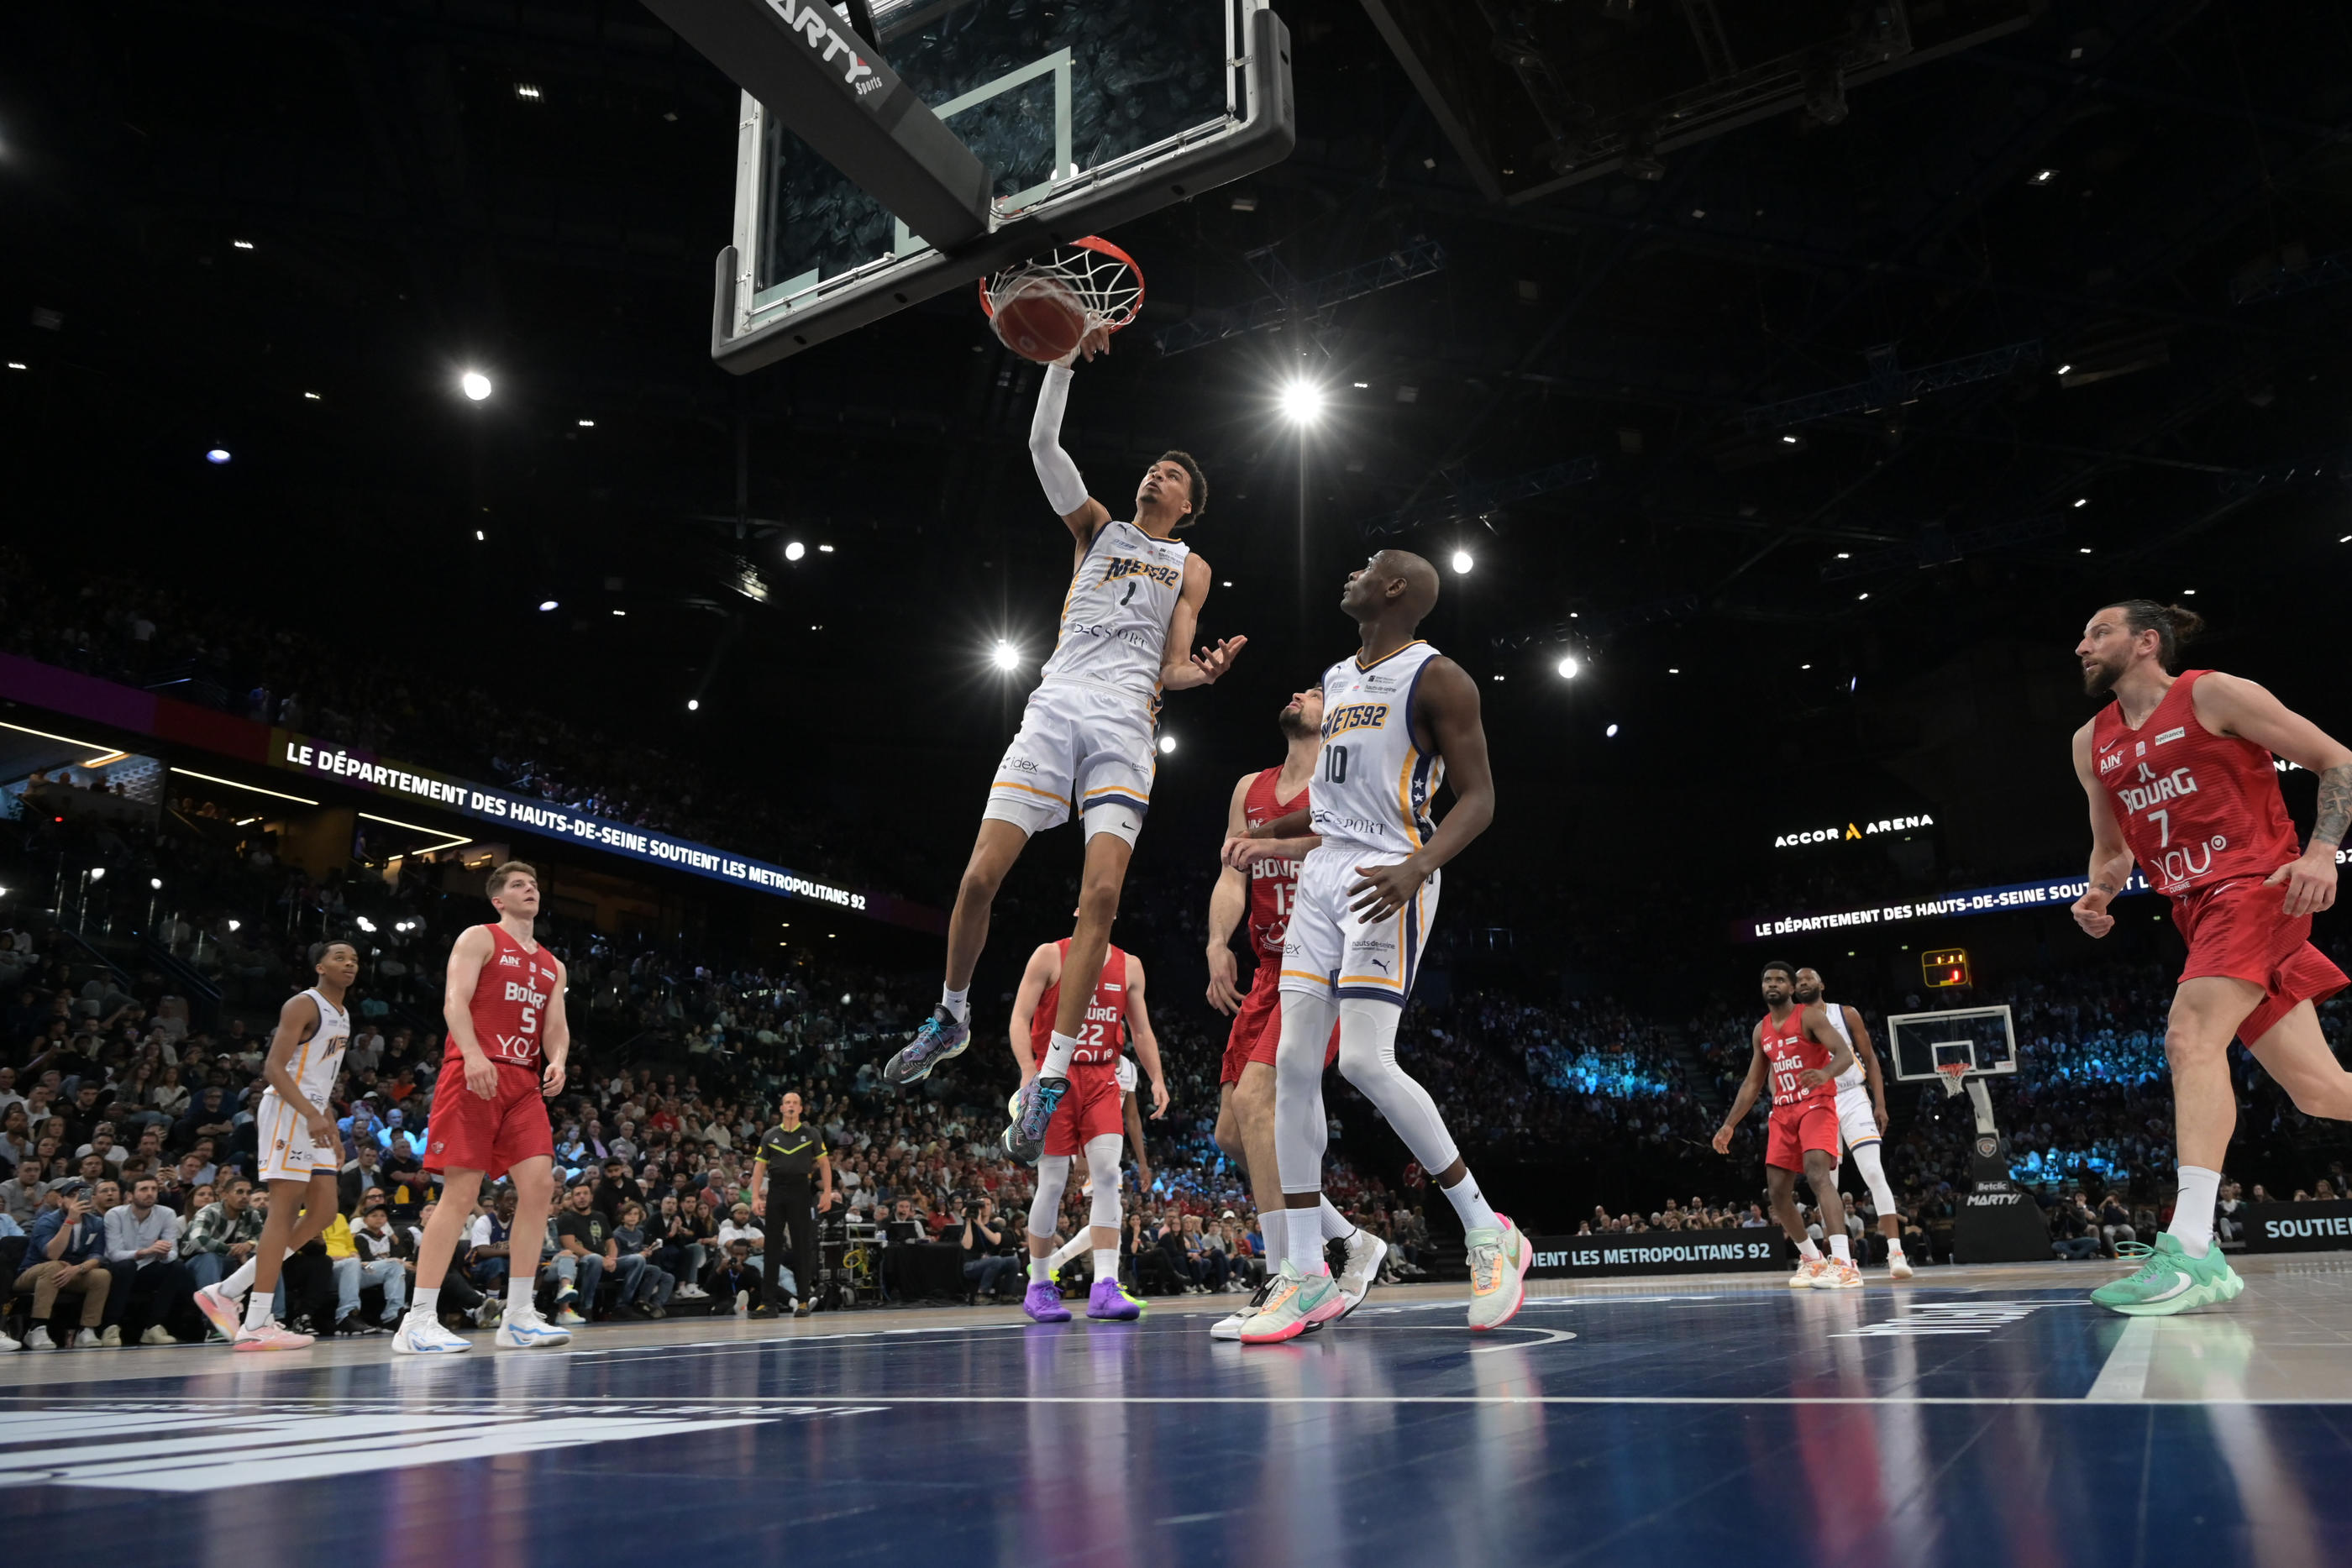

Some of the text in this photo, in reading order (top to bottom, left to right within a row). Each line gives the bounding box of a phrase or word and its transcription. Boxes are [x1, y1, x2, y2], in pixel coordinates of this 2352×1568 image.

[765, 0, 872, 83] ARTY
[855, 76, 883, 95] Sports
[1120, 581, 1137, 606] 1
[1011, 757, 1039, 773] idex
[1326, 744, 1347, 784] 10
[2100, 754, 2121, 773] AIN
[2118, 768, 2198, 815] BOURG
[286, 742, 866, 910] LE DÉPARTEMENT DES HAUTS-DE-SEINE SOUTIENT LES METROPOLITANS 92
[1775, 814, 1934, 848] ACCOR ARENA
[2147, 809, 2168, 848] 7
[1252, 858, 1305, 880] BOUR
[2169, 881, 2192, 894] CUISINE
[1755, 922, 1772, 937] LE
[1774, 909, 1880, 935] DÉPARTEMENT
[1883, 905, 1913, 921] DES
[1915, 887, 2046, 917] HAUTS-DE-SEINE
[2049, 876, 2134, 900] SOUTT
[520, 1008, 536, 1034] 5
[1085, 1006, 1117, 1022] URG
[1076, 1023, 1104, 1046] 22
[1773, 1055, 1803, 1073] OURG
[1777, 1072, 1796, 1092] 10
[1978, 1182, 2007, 1191] Betclic
[1966, 1194, 2016, 1207] MARTY
[1532, 1243, 1771, 1267] IENT LES METROPOLITANS 92
